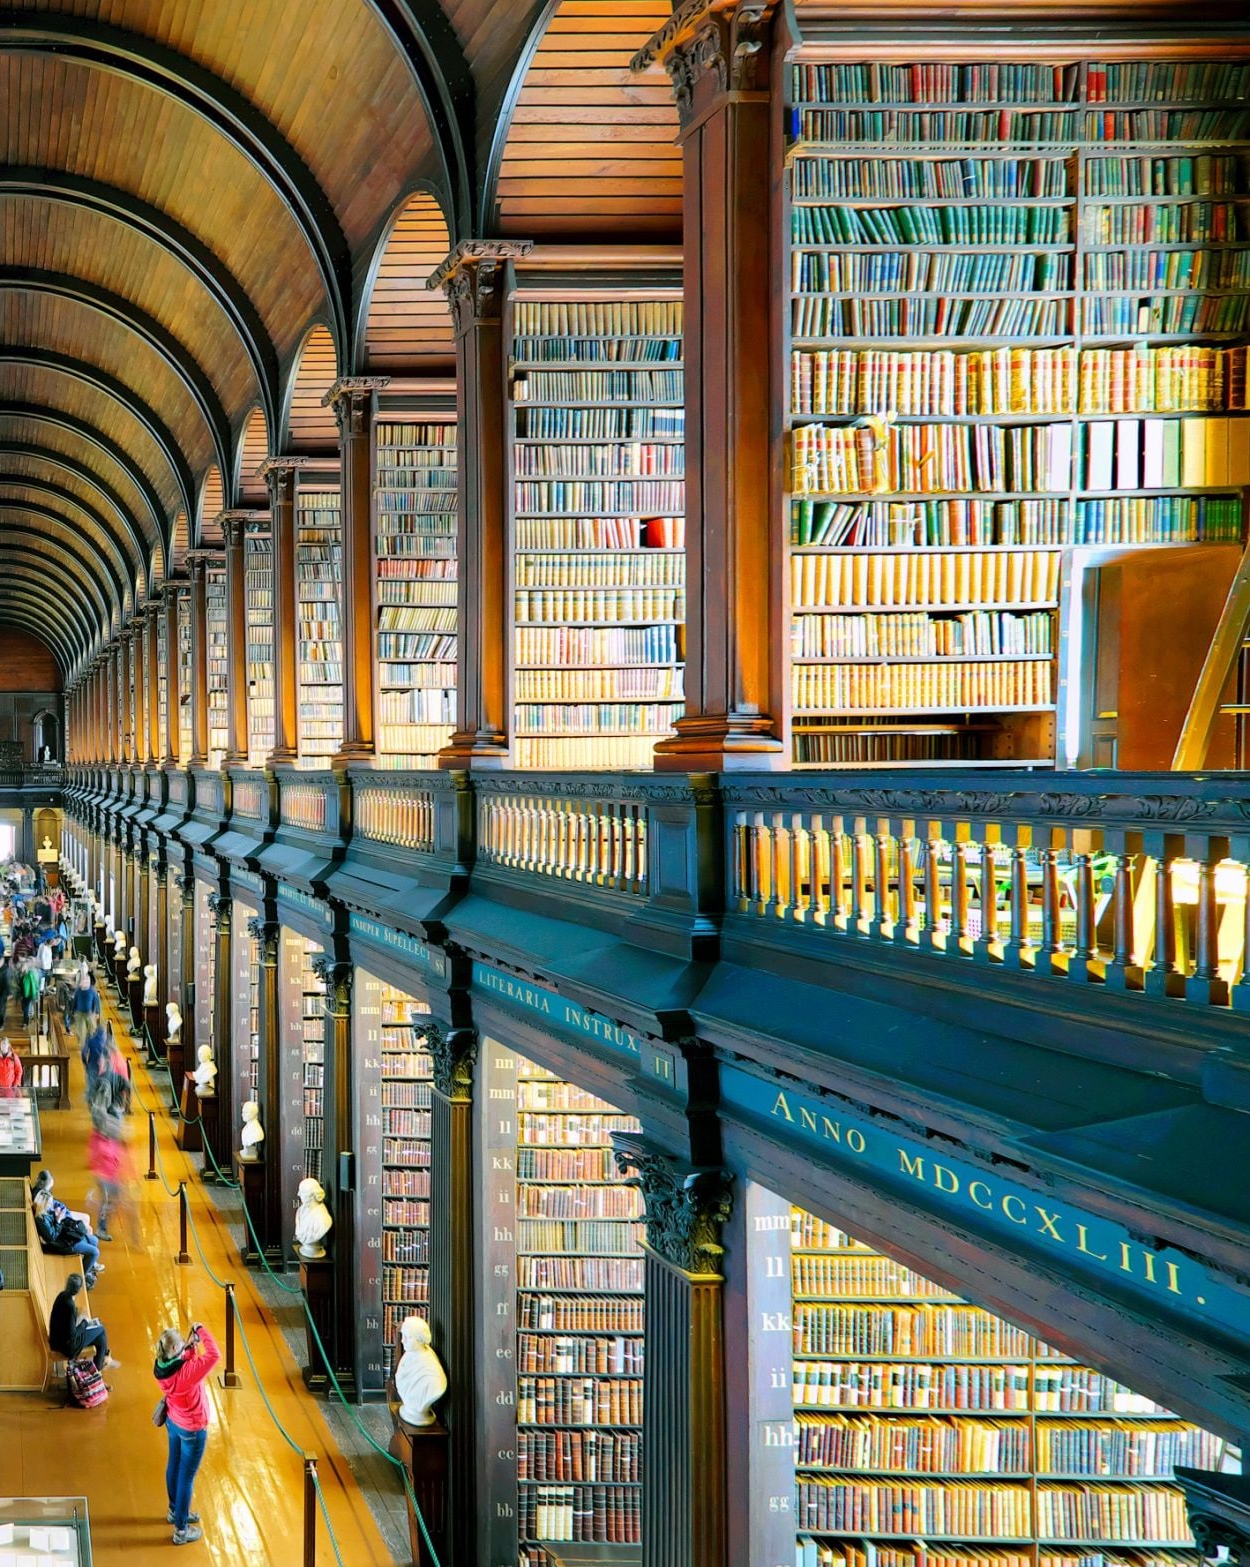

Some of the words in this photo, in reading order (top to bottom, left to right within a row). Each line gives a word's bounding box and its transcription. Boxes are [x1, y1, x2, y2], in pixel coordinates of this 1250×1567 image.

[366, 982, 379, 990] nn
[479, 969, 550, 1014] LITERARIA
[565, 1006, 638, 1053] INSTRUX
[367, 1030, 377, 1041] ll
[365, 1059, 380, 1068] kk
[495, 1059, 514, 1069] nn
[370, 1086, 377, 1096] ii
[489, 1089, 516, 1100] mm
[367, 1114, 380, 1126] hh
[500, 1121, 511, 1134] ll
[493, 1157, 512, 1169] kk
[369, 1175, 378, 1184] ff
[499, 1190, 510, 1203] ii
[771, 1091, 866, 1154] ANNO
[898, 1148, 1207, 1305] MDCCXLIII.
[754, 1216, 789, 1231] mm
[494, 1227, 513, 1241] hh
[368, 1237, 381, 1248] dd
[494, 1265, 508, 1276] gg
[766, 1257, 783, 1277] ll
[369, 1277, 381, 1285] cc
[497, 1303, 509, 1315] ff
[366, 1319, 378, 1329] bb
[762, 1312, 791, 1331] kk
[496, 1349, 512, 1358] ee
[771, 1368, 786, 1388] ii
[496, 1391, 513, 1405] dd
[765, 1426, 793, 1446] hh
[498, 1450, 514, 1460] cc
[769, 1496, 789, 1511] gg
[497, 1503, 513, 1517] bb
